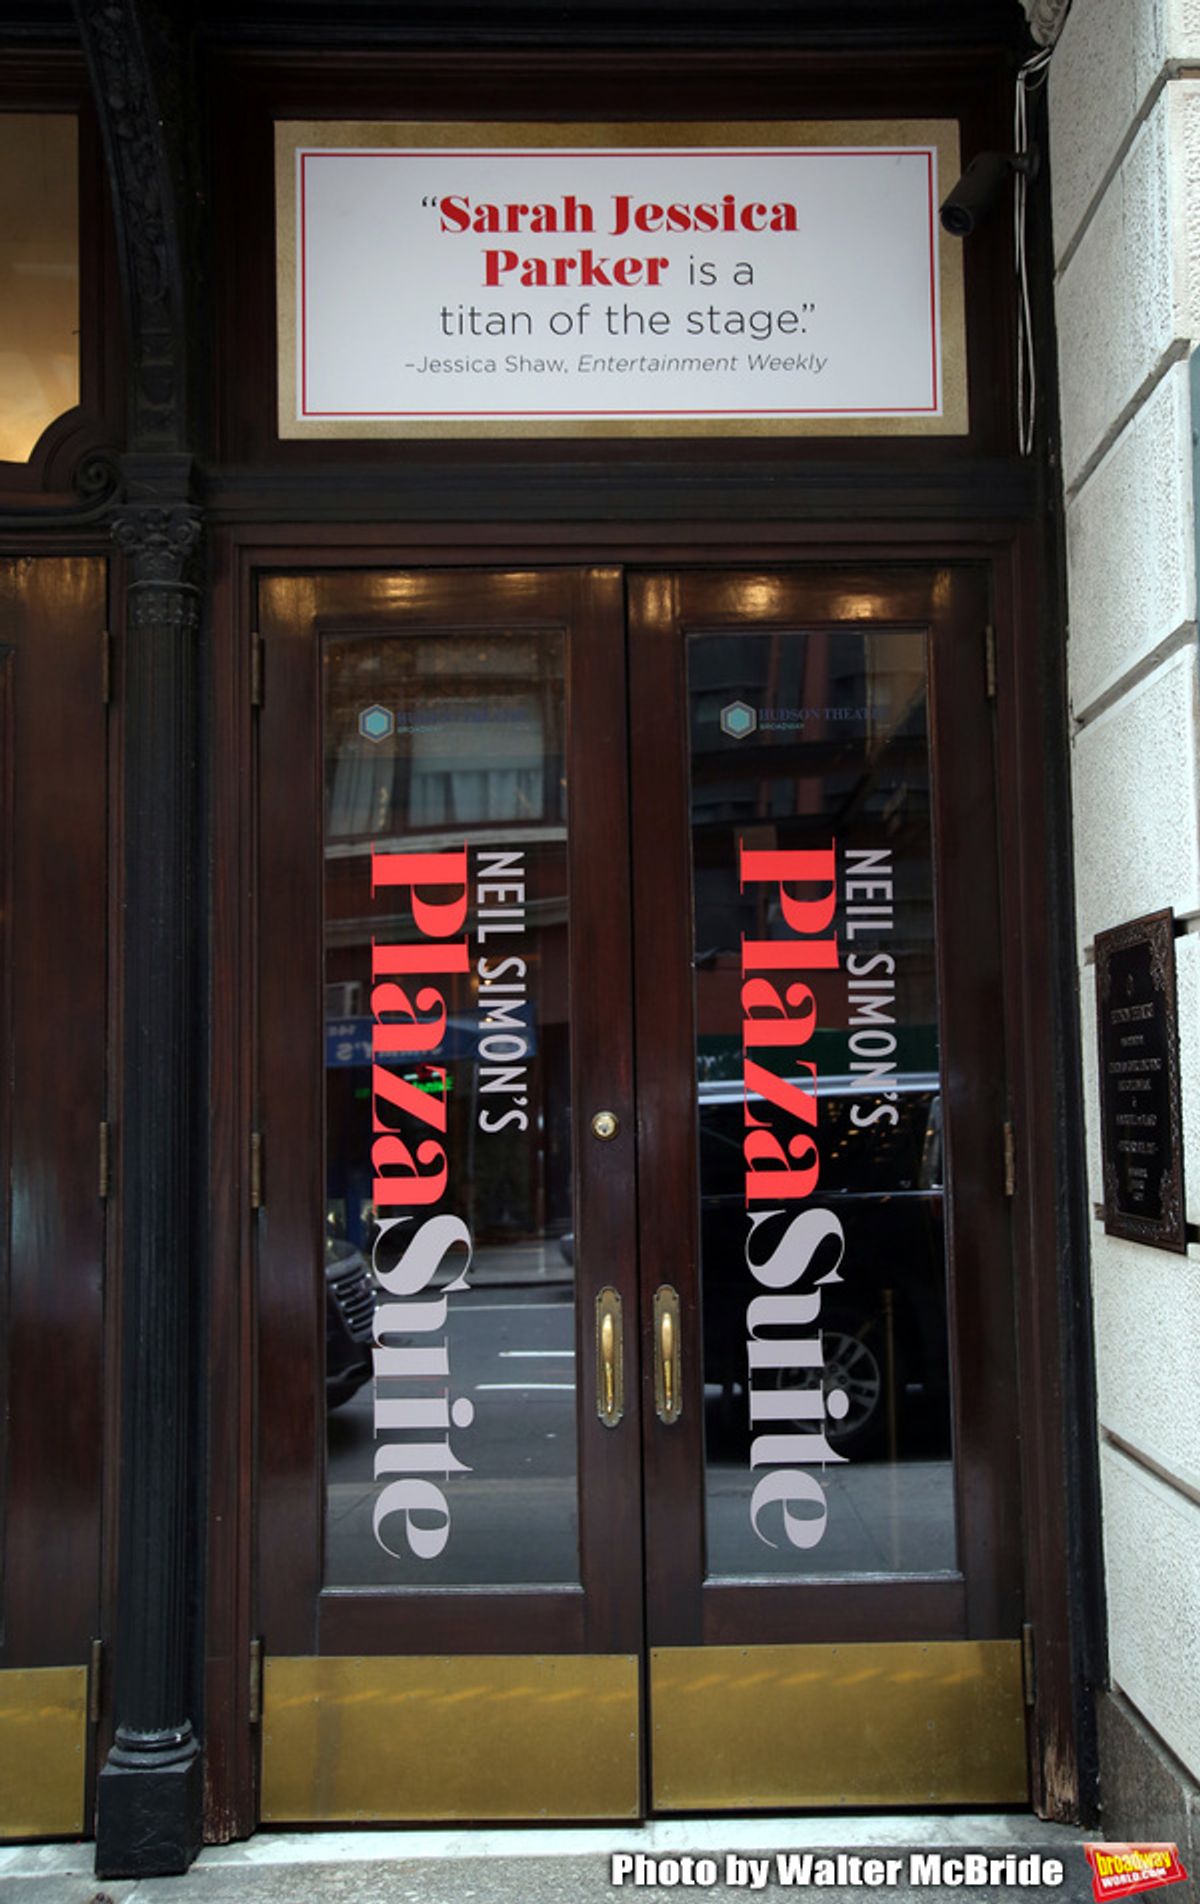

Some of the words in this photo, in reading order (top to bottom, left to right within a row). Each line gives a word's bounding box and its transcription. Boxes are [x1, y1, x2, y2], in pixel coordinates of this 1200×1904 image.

[421, 195, 595, 235] “Sarah
[609, 194, 800, 235] Jessica
[482, 249, 670, 287] Parker
[689, 255, 718, 286] is
[733, 262, 755, 286] a
[441, 304, 533, 336] titan
[549, 303, 591, 335] of
[606, 303, 671, 335] the
[687, 303, 816, 341] stage.”
[505, 355, 570, 376] Shaw,
[577, 354, 738, 373] Entertainment
[747, 354, 828, 374] Weekly
[476, 851, 526, 944] NEIL
[844, 849, 894, 941] NEIL
[476, 955, 529, 1134] SIMON'S
[846, 952, 900, 1128] SIMON'S
